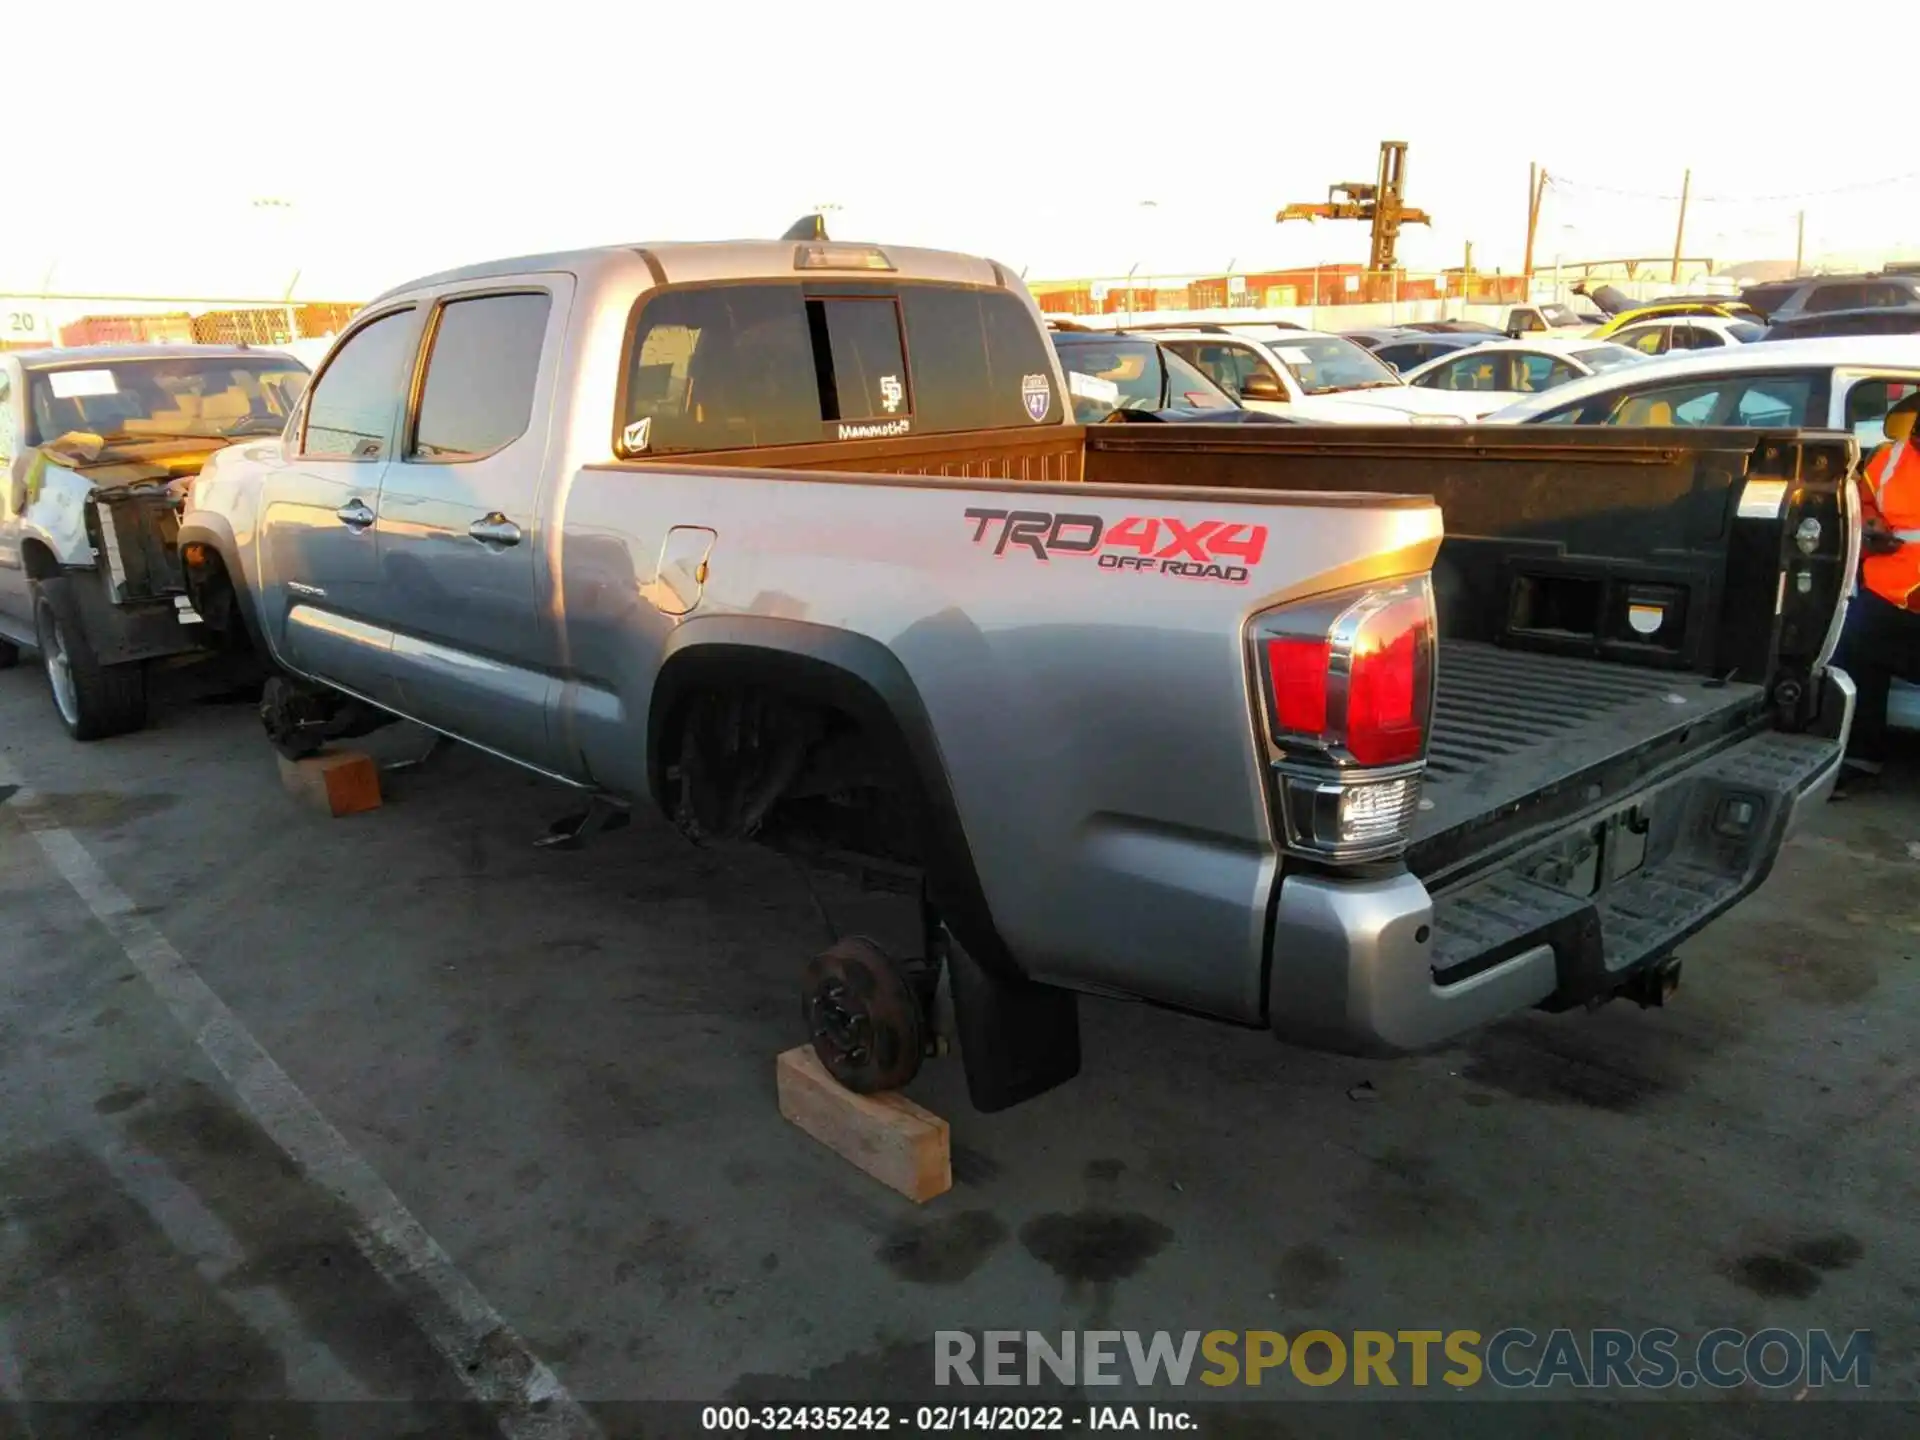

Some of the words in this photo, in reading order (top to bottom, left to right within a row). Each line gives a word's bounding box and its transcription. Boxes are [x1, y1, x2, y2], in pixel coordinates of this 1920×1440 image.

[10, 312, 34, 331] 20
[1098, 554, 1156, 573] OFF
[1159, 559, 1251, 585] ROAD
